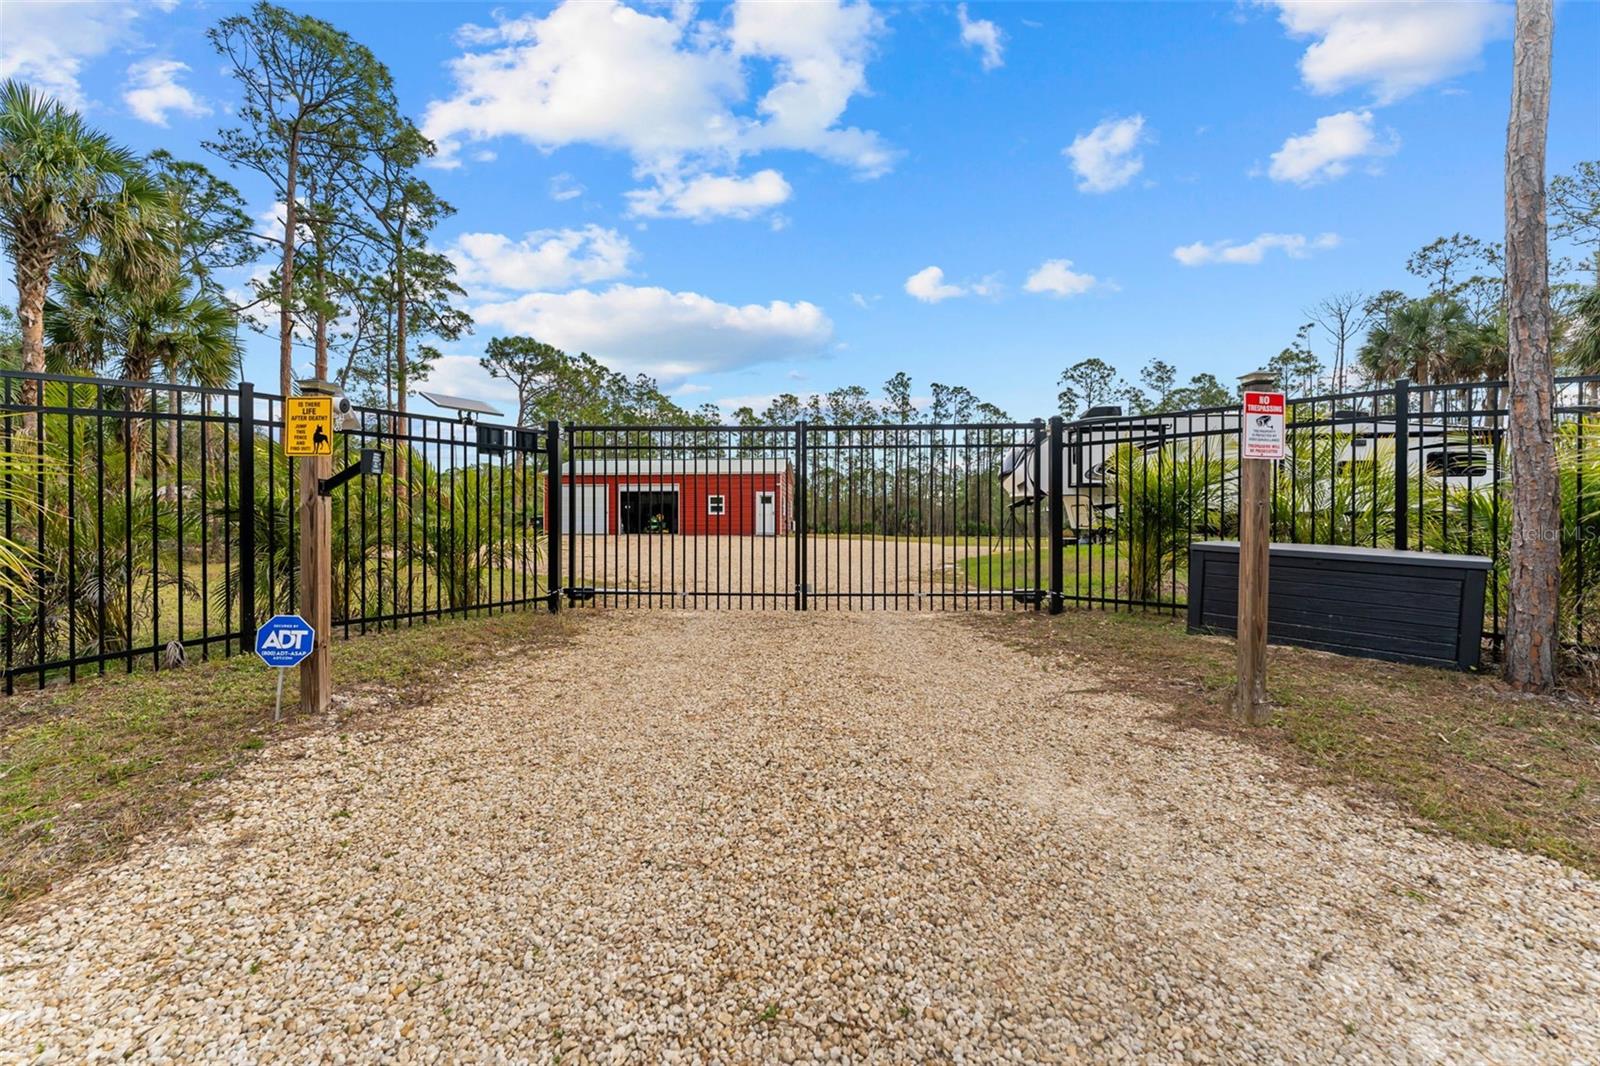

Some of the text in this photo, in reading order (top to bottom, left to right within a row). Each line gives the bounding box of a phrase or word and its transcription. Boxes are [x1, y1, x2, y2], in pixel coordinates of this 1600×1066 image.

[1258, 396, 1270, 405] NO
[1248, 404, 1282, 412] TRESPASSING
[262, 630, 308, 649] ADT
